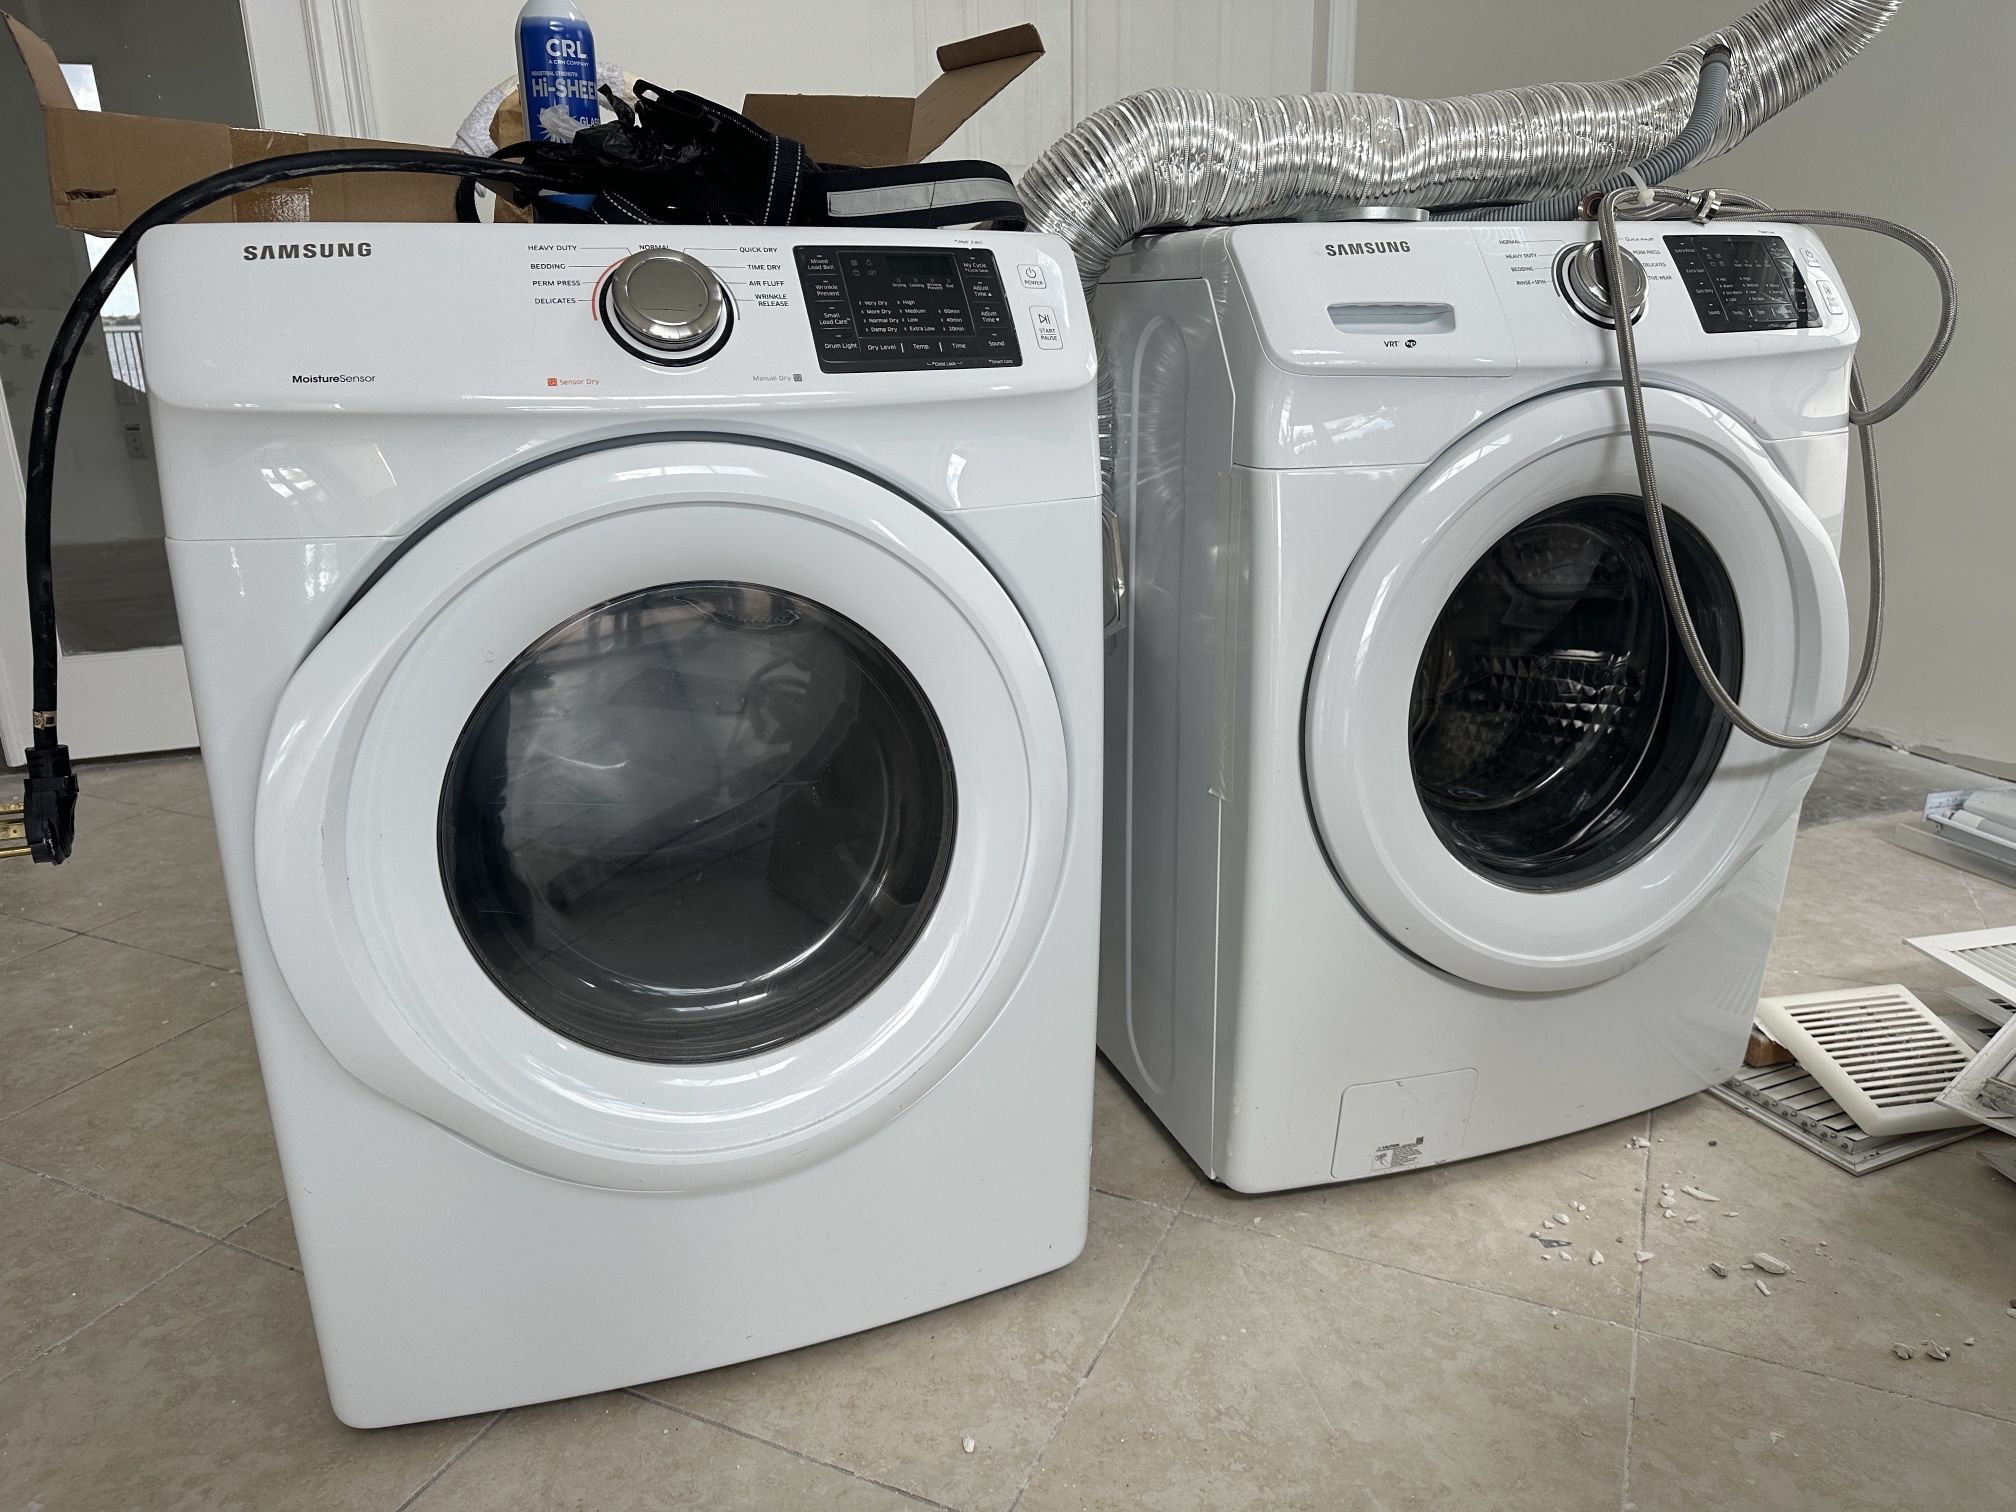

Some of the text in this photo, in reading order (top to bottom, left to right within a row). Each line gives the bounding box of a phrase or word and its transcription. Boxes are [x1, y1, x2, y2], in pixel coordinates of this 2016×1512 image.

[546, 38, 588, 59] CRL
[243, 243, 373, 261] SAMSUNG
[1325, 241, 1411, 257] SAMSUNG
[557, 279, 581, 287] PRESS
[534, 297, 576, 305] DELICATES
[292, 374, 376, 384] MoistureSensor
[559, 378, 600, 386] Sensor Dry
